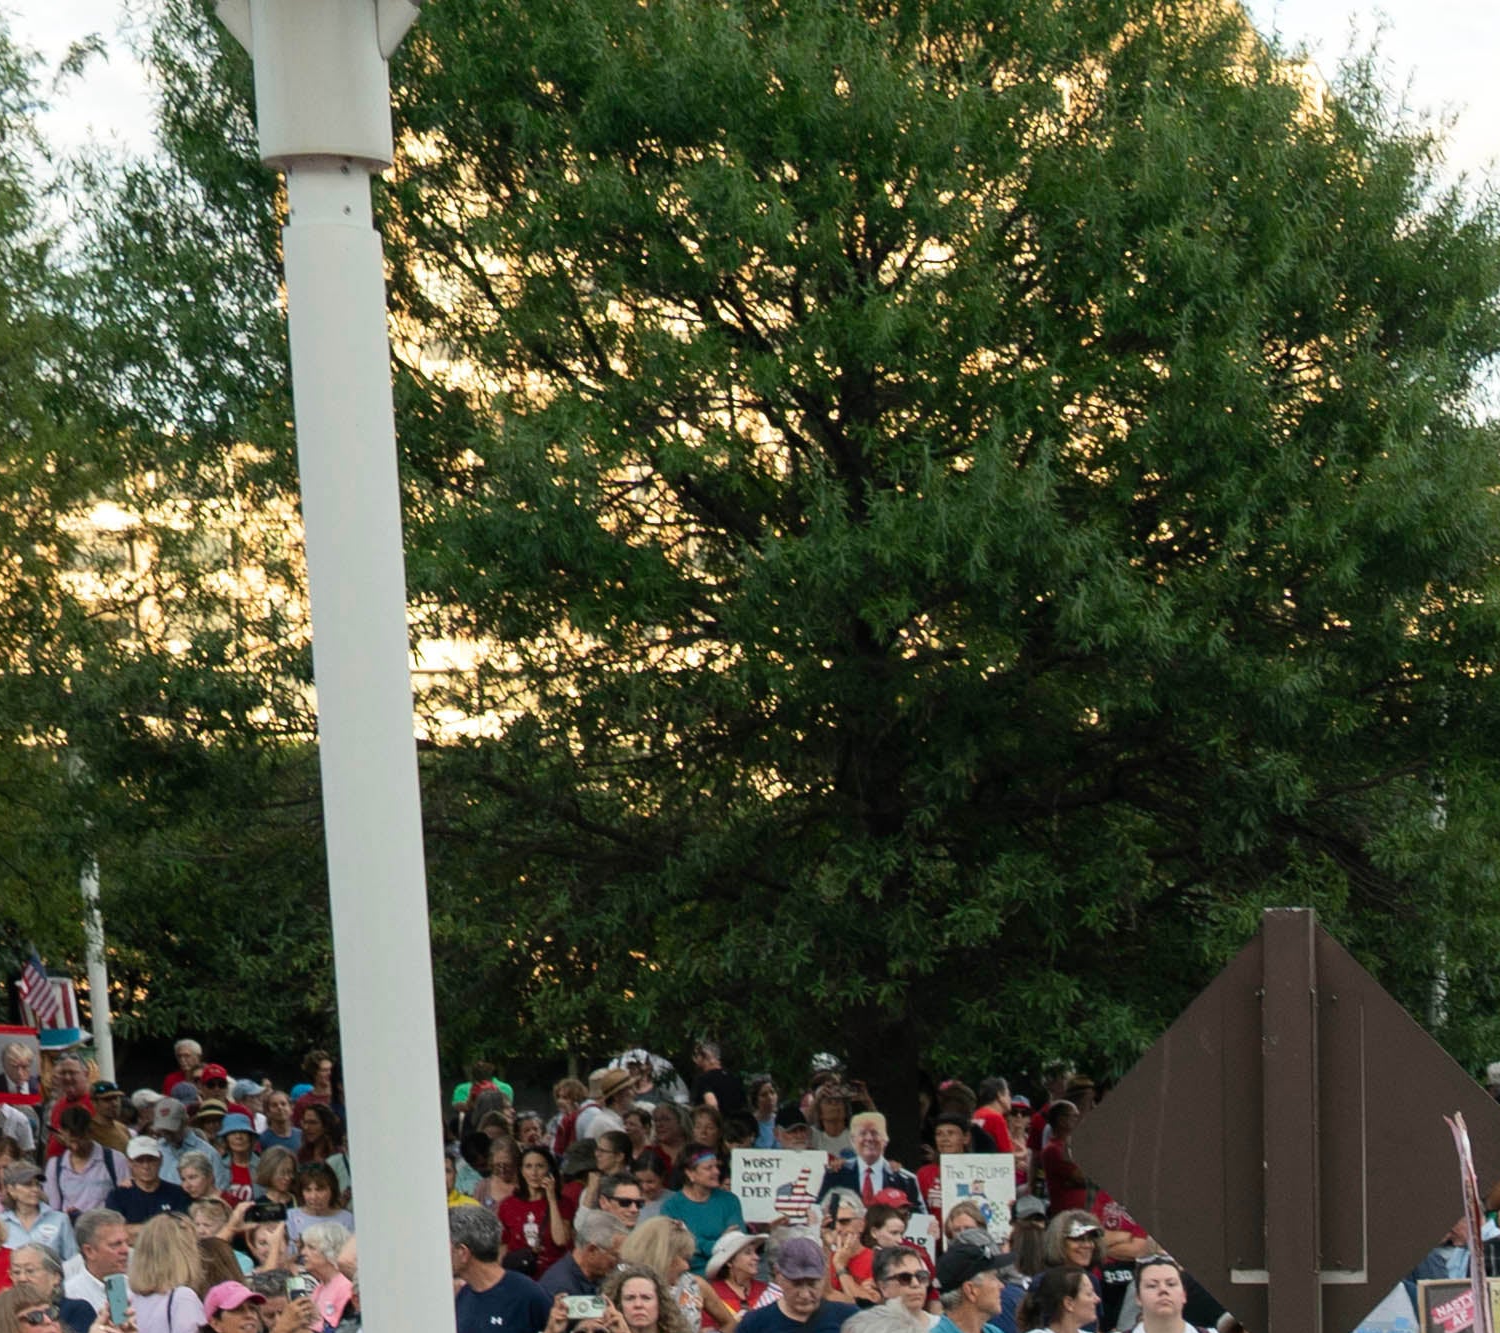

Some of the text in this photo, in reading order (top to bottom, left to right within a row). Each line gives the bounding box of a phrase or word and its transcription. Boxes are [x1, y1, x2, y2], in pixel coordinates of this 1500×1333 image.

[742, 1157, 781, 1170] WORST
[968, 1164, 1011, 1180] TRUMP
[742, 1185, 772, 1198] EVER
[1435, 1291, 1476, 1318] NASTY
[1451, 1312, 1470, 1327] AF
